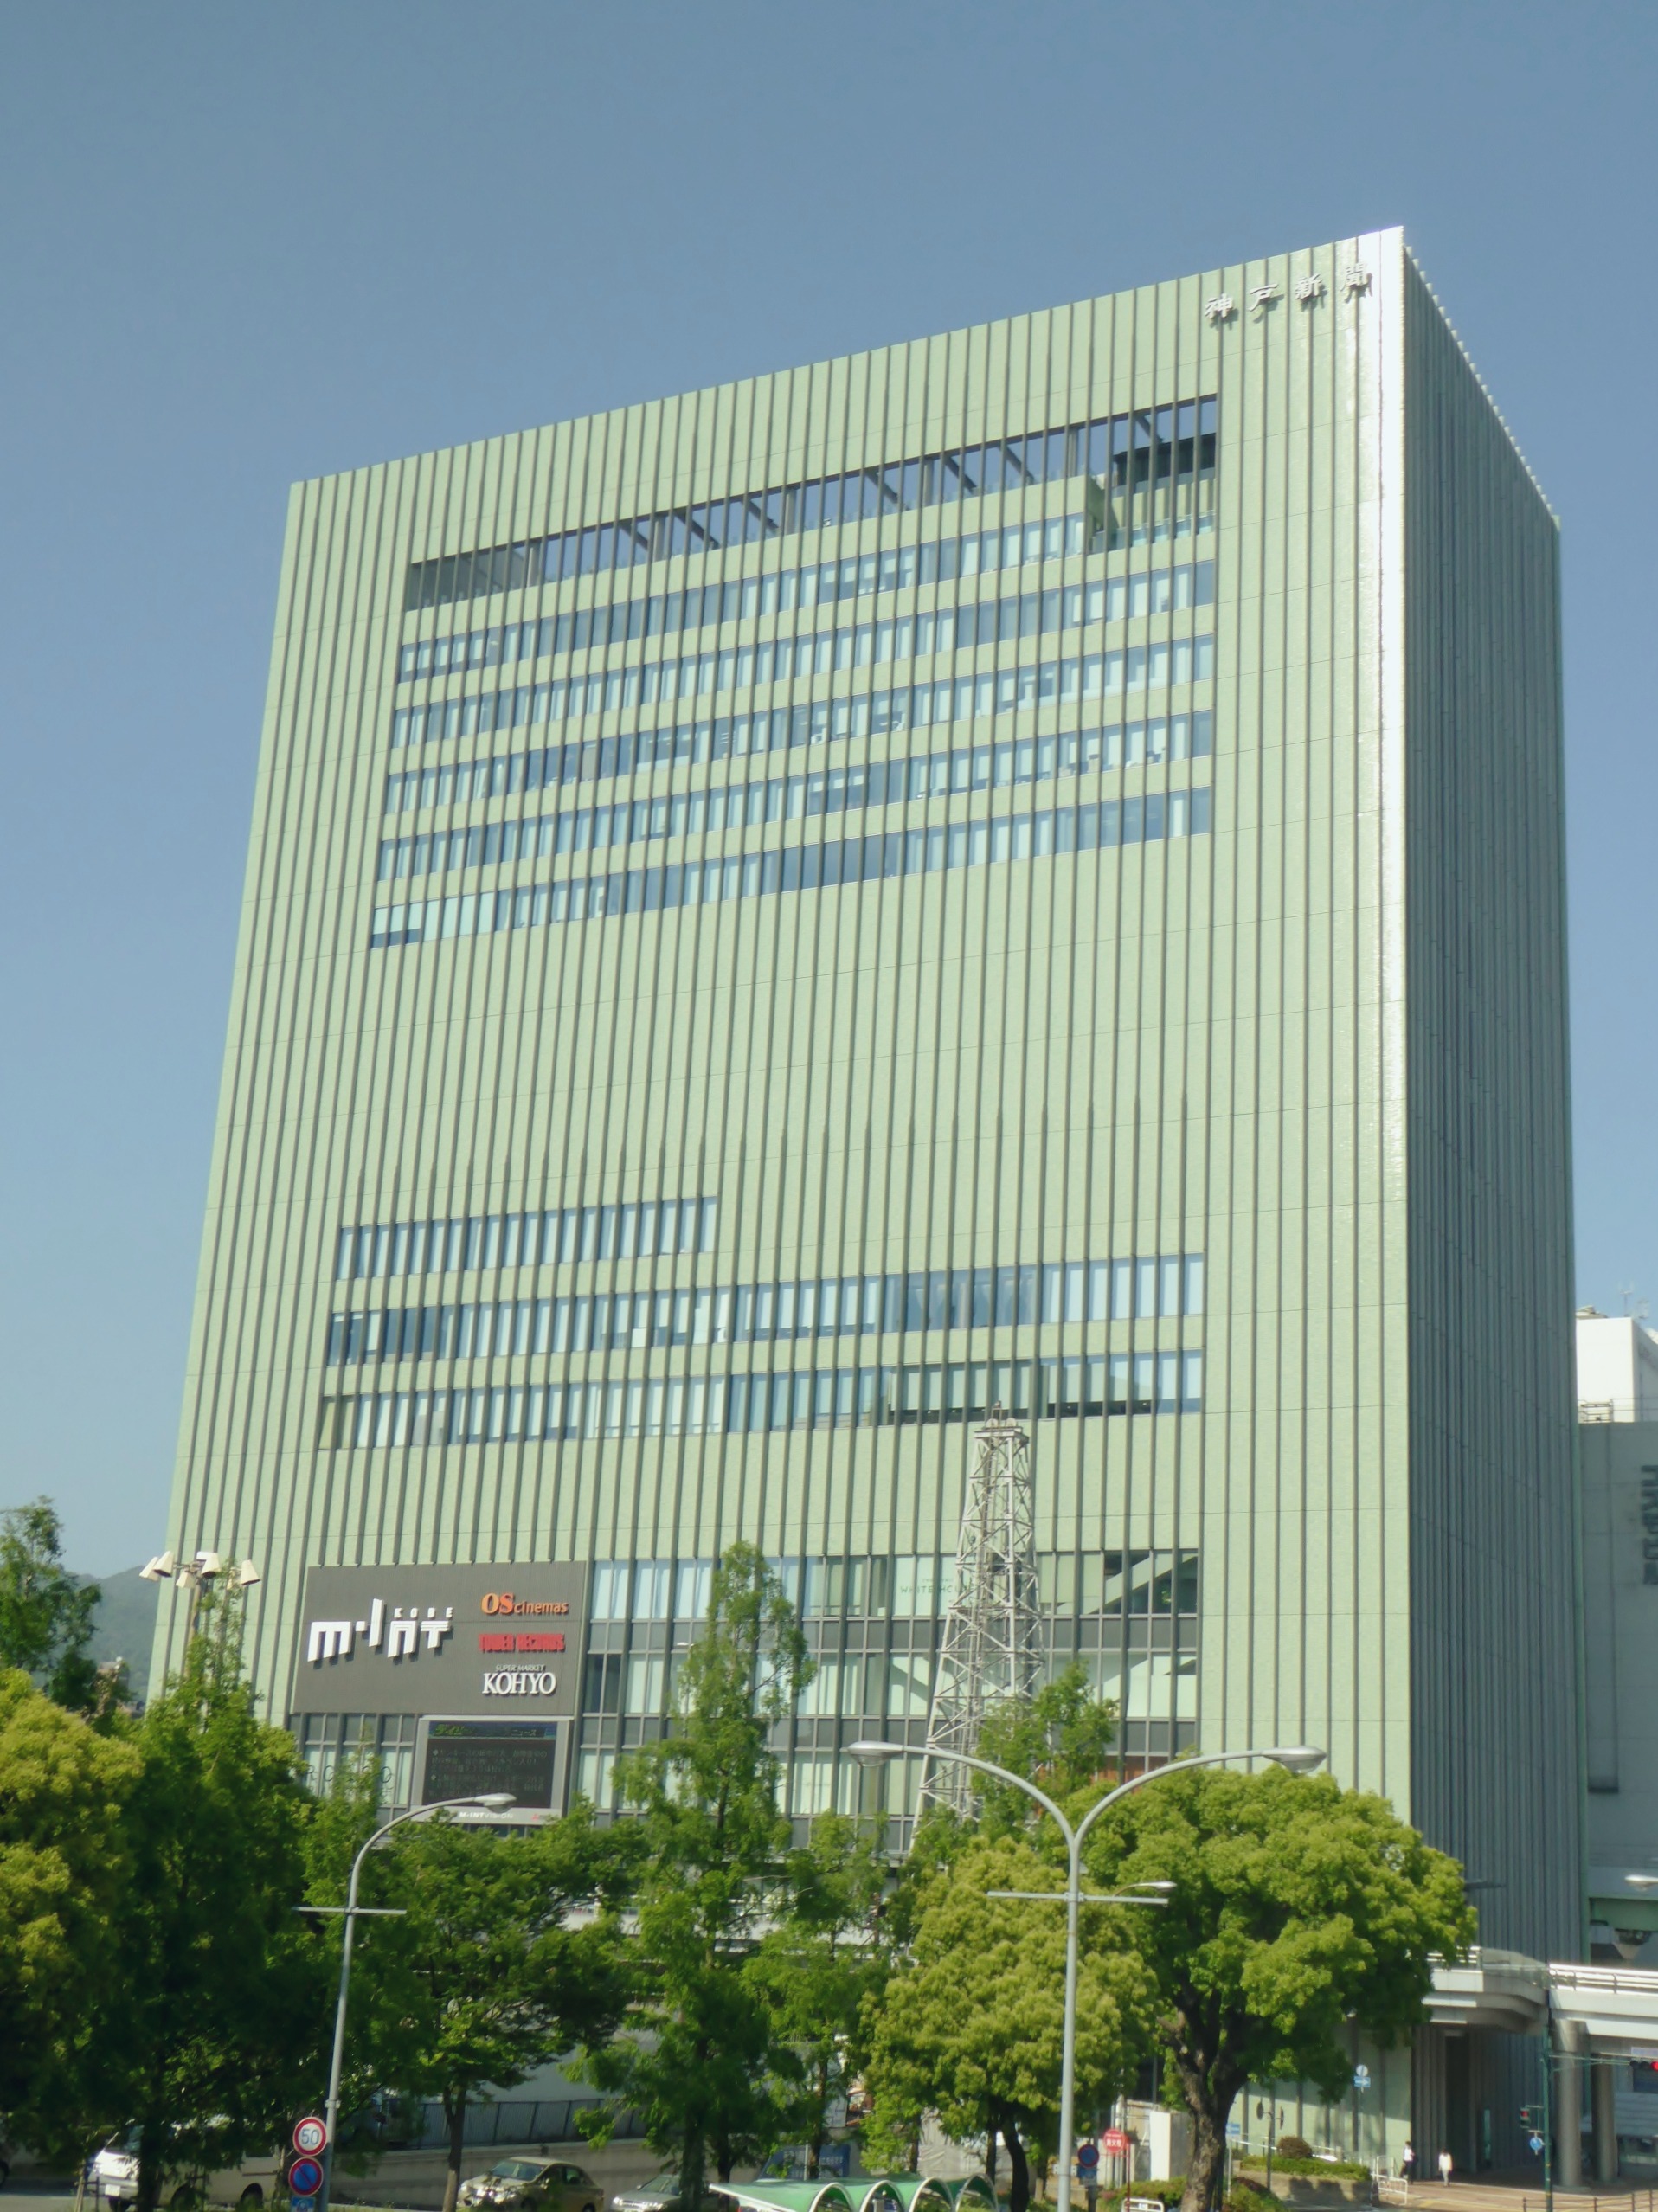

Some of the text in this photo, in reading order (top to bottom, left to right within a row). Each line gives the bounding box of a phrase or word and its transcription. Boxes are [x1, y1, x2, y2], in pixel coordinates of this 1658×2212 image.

[1204, 262, 1370, 318] 神戸新聞
[482, 1671, 556, 1695] KOHYO
[301, 2128, 320, 2145] 50
